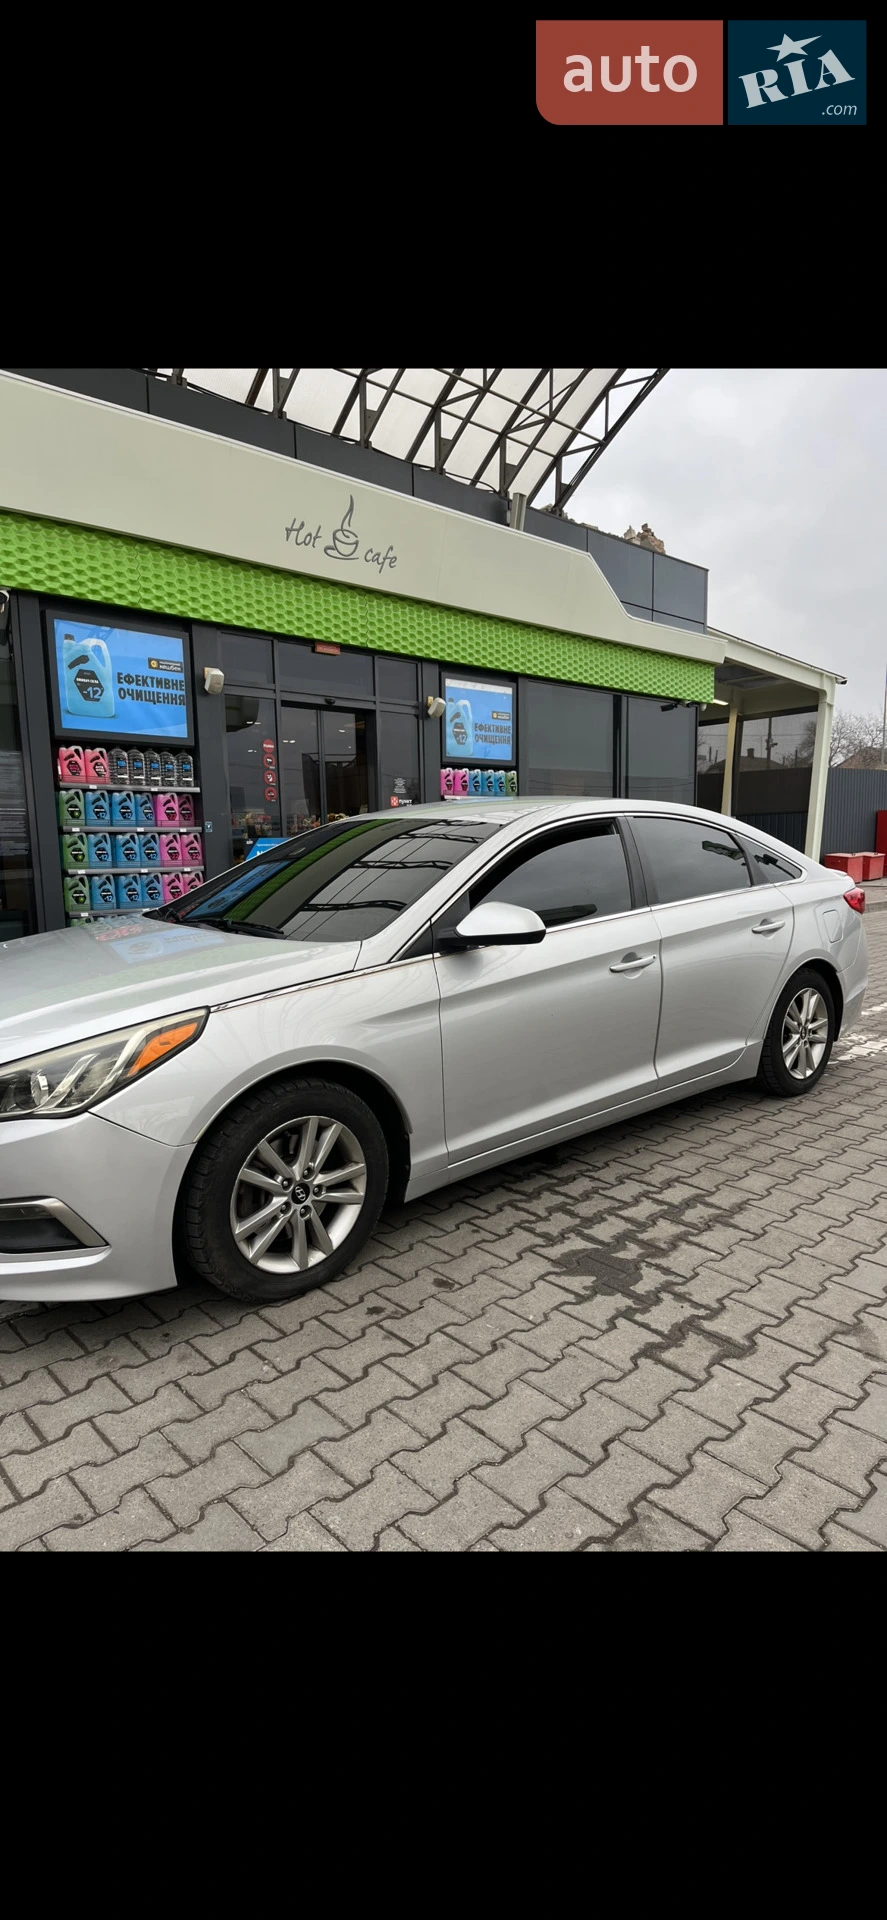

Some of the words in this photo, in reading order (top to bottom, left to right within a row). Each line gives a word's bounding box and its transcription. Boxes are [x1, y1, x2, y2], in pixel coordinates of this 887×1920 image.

[285, 518, 322, 548] Hot
[364, 545, 397, 574] cafe
[117, 672, 185, 692] ЕФЕКТИВНЕ
[118, 687, 186, 706] ОЧИЩЕННЯ
[474, 723, 511, 735] ЕФЕКТИВНЕ
